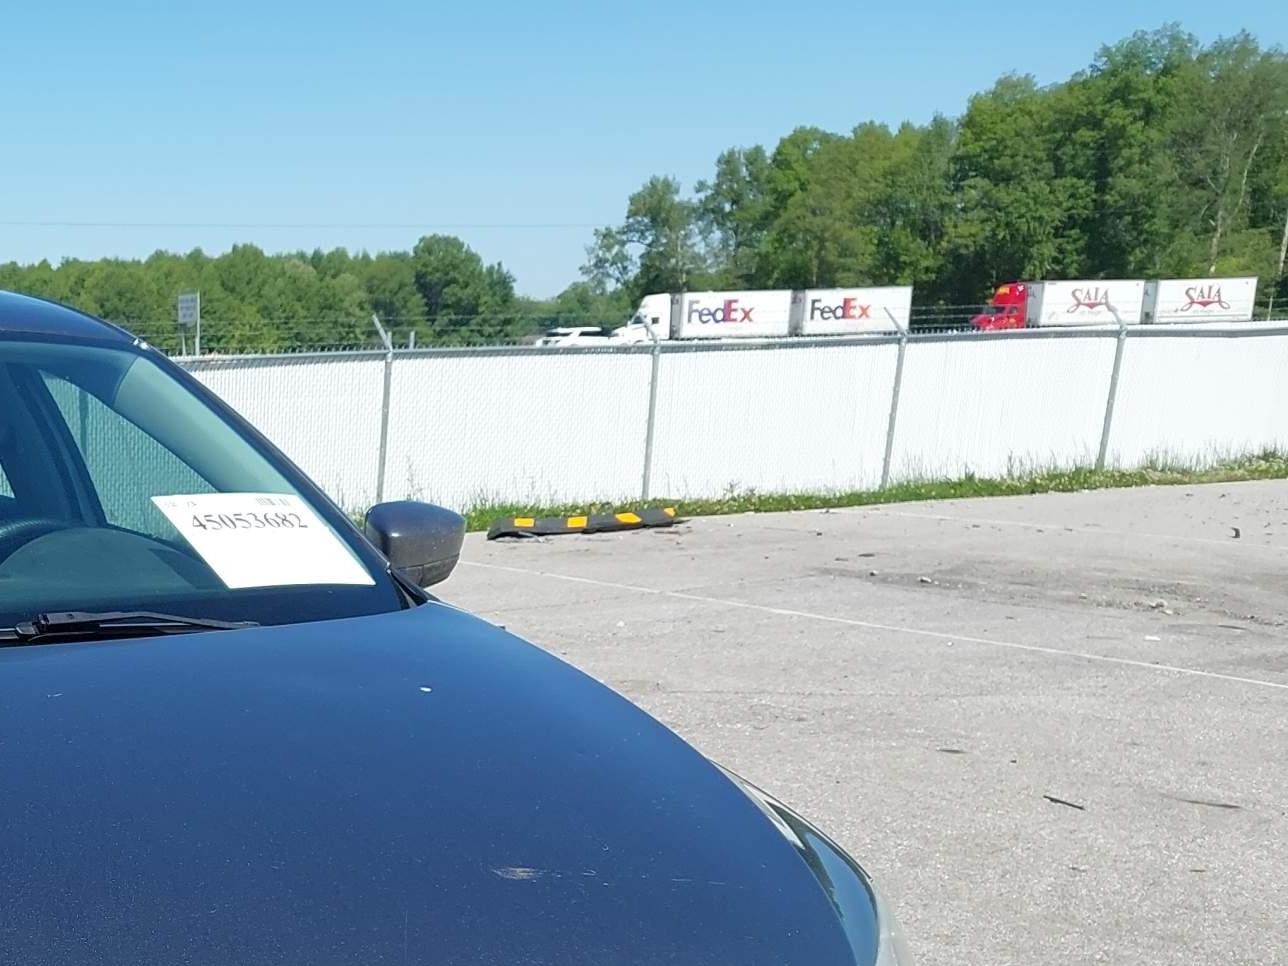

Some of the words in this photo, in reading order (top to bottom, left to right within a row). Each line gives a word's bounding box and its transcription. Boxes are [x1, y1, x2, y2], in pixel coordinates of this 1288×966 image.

[1069, 287, 1111, 307] SAIA
[1183, 285, 1224, 306] SAIA
[687, 299, 754, 323] FedEx
[810, 297, 872, 320] FedEx
[192, 511, 309, 531] 45053682
